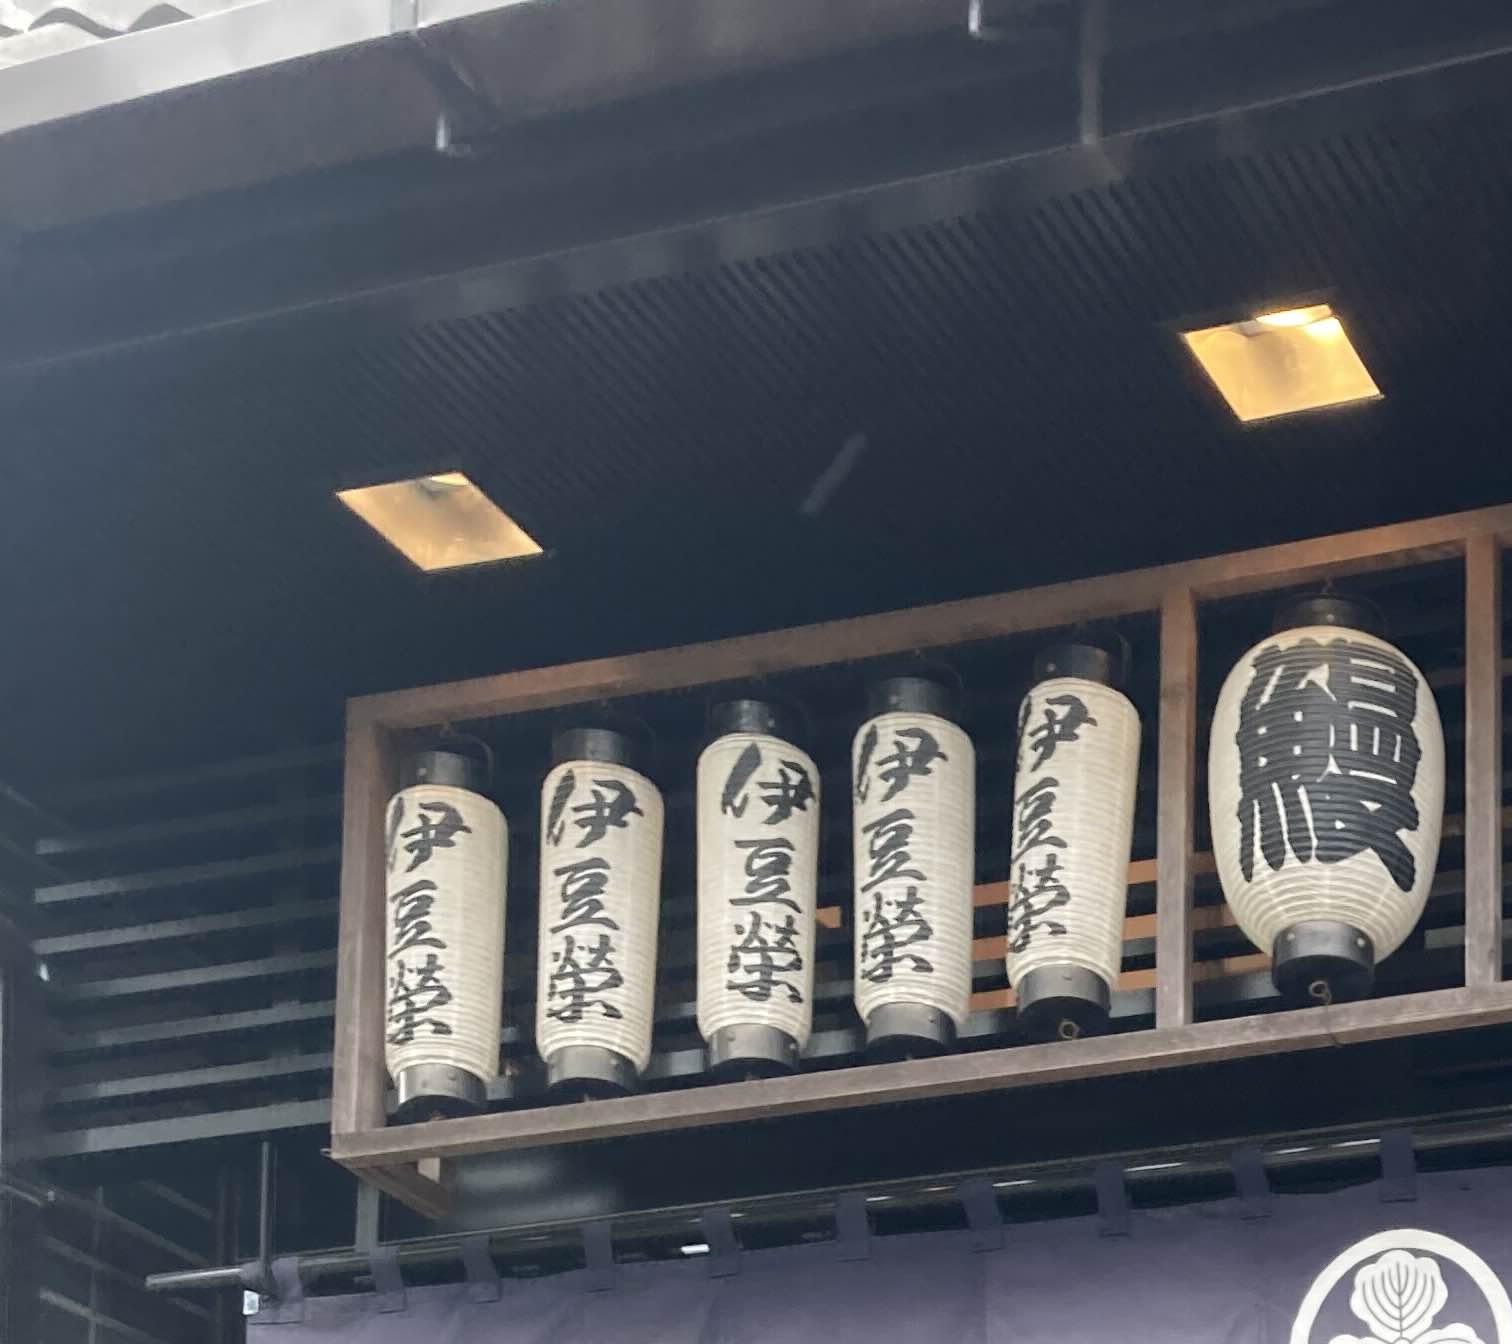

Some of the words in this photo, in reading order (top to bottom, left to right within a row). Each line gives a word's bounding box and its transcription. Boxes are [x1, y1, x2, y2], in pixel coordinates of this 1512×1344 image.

[385, 798, 472, 1045] 伊豆榮
[546, 770, 644, 1024] 伊豆榮
[721, 742, 816, 1004] 伊豆榮
[854, 724, 949, 982] 伊豆榮
[1008, 693, 1097, 954] 伊豆榮
